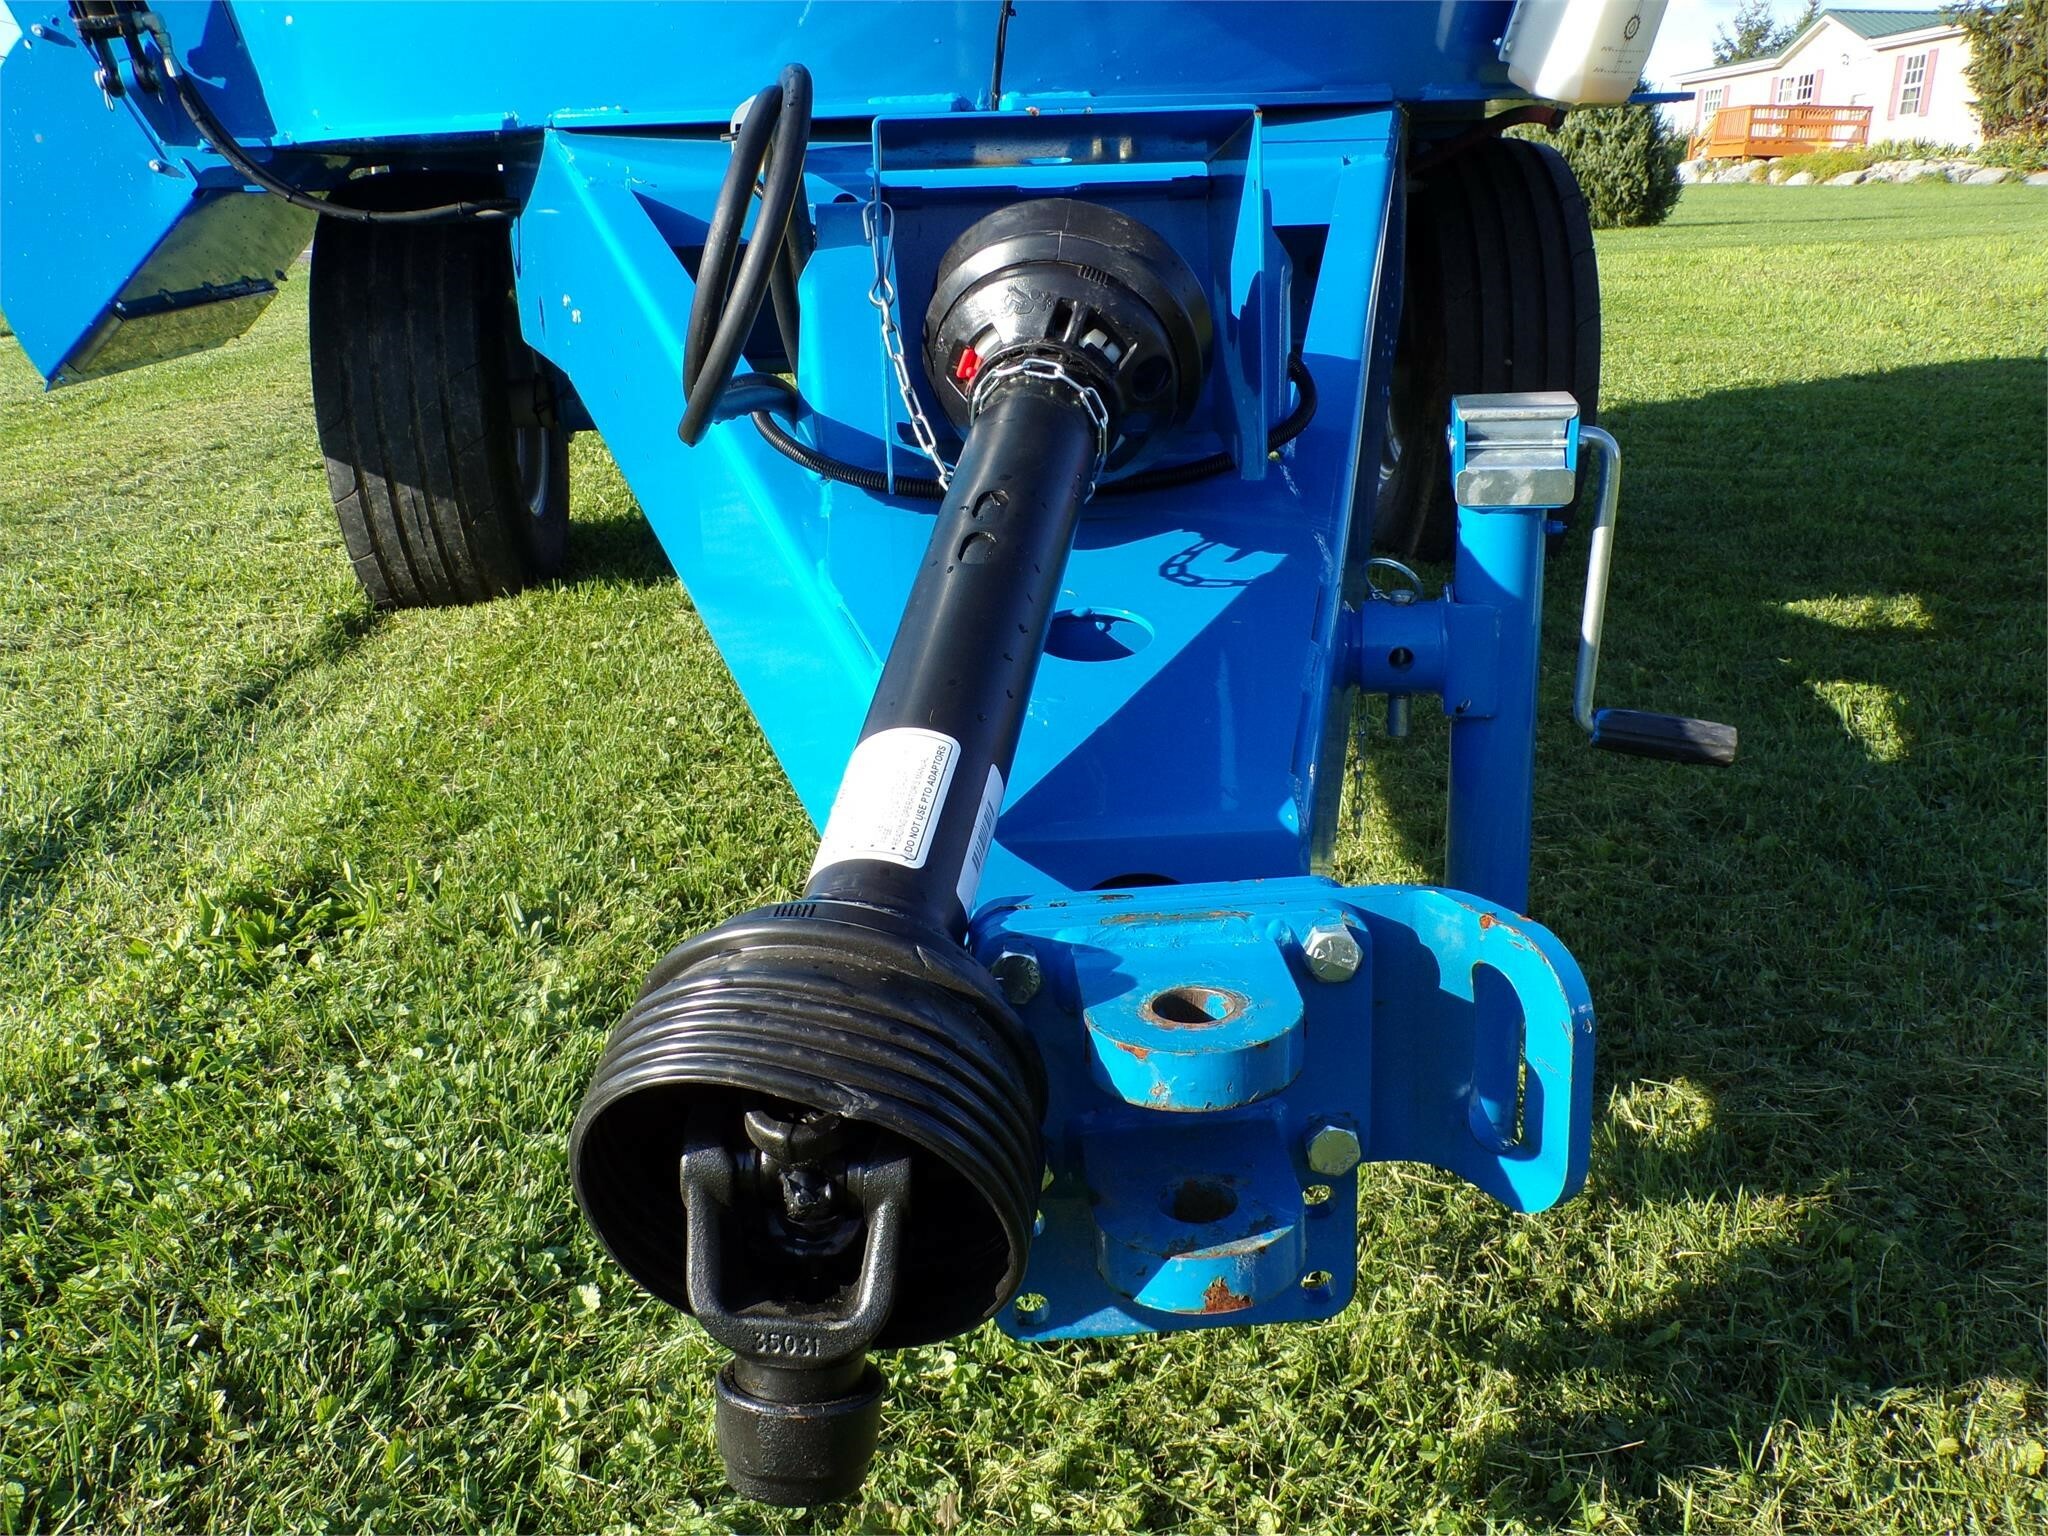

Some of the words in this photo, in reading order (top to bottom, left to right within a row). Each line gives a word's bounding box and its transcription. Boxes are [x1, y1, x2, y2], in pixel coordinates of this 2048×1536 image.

[925, 743, 947, 787] ADAPTORS
[920, 785, 933, 804] PTO
[914, 802, 927, 821] USE
[908, 820, 921, 839] NOT
[903, 838, 915, 854] DO
